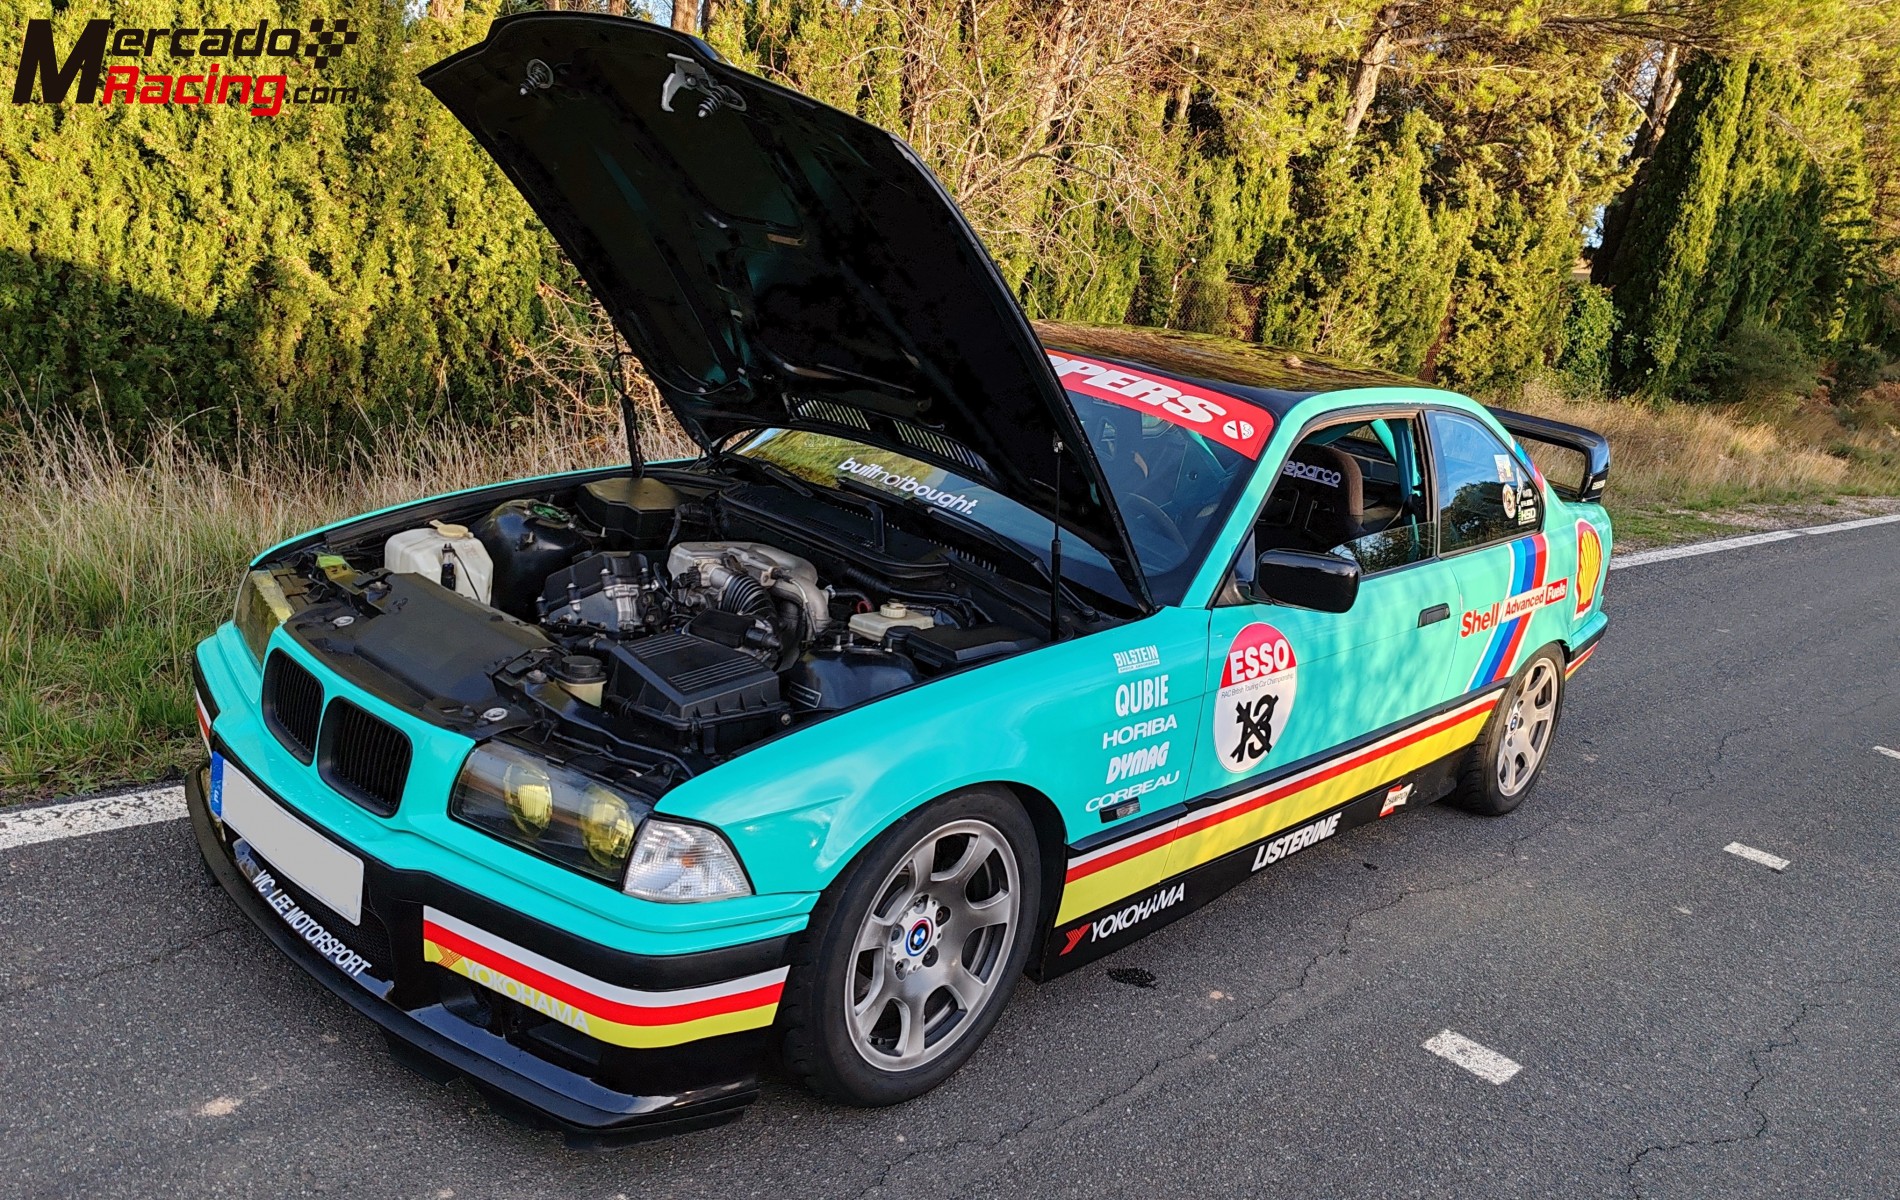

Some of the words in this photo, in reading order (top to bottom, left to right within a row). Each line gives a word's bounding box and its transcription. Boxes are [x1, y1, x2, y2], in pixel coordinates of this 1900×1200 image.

[1460, 602, 1500, 638] Shell
[1504, 589, 1545, 617] Advanced
[1547, 581, 1567, 602] Fuels
[1113, 645, 1159, 667] BILSTEIN
[1229, 638, 1289, 684] ESSO
[1115, 674, 1169, 717] QUBIE
[1103, 714, 1177, 749] HORIBA
[1106, 741, 1170, 784] DYMAG
[1085, 771, 1180, 812] CORBEAU
[1251, 812, 1342, 872] LISTERINE
[251, 870, 277, 893] VIC
[265, 886, 290, 917] LEE
[282, 906, 373, 977] MOTORSPORT
[1090, 882, 1185, 943] YOKOHAMA
[463, 960, 590, 1035] YOKOHAMA
